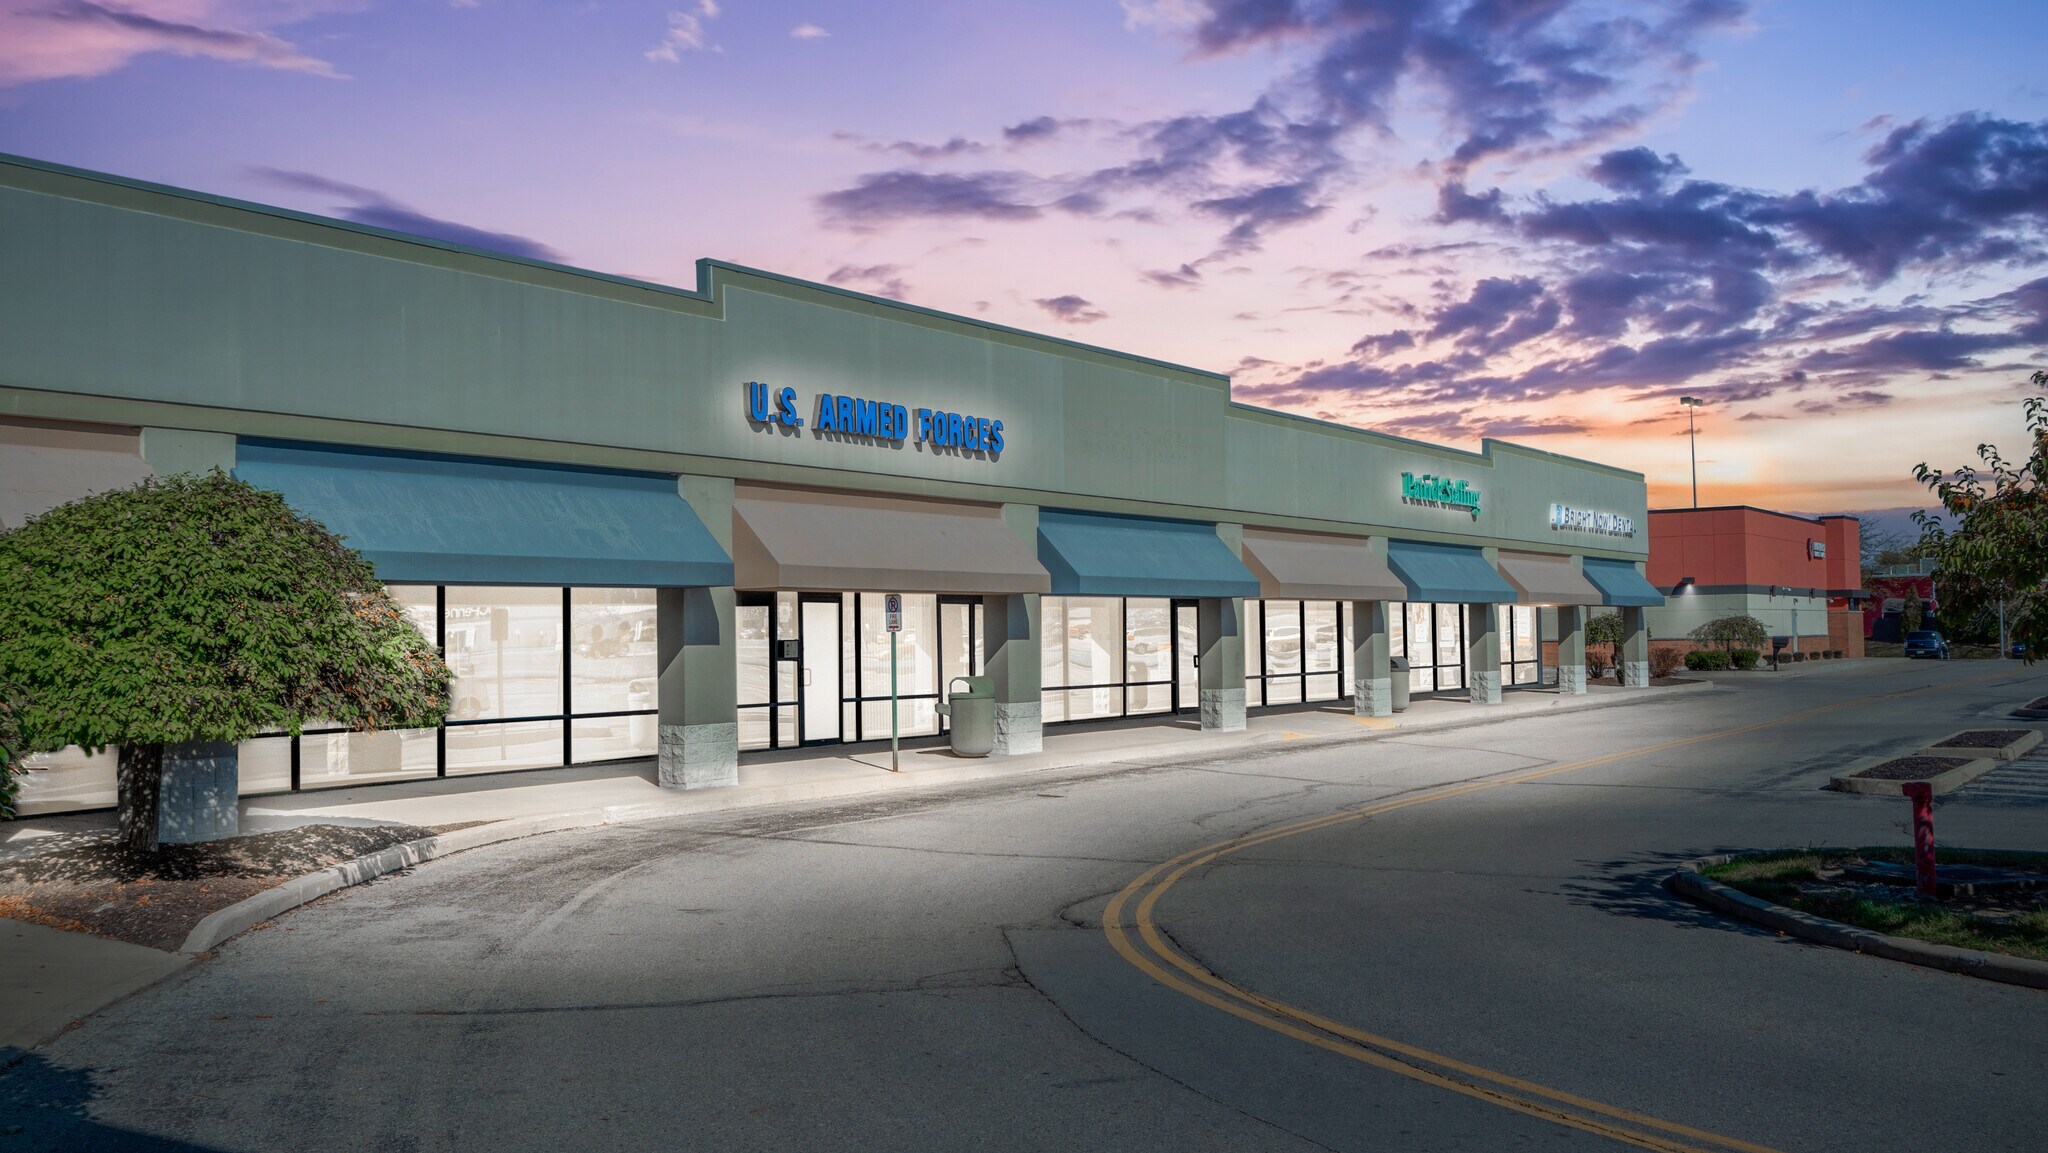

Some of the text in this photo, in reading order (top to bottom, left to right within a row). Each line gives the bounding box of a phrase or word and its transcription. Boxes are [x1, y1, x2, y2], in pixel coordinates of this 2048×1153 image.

[744, 381, 1005, 454] U.S. ARMED FORCES
